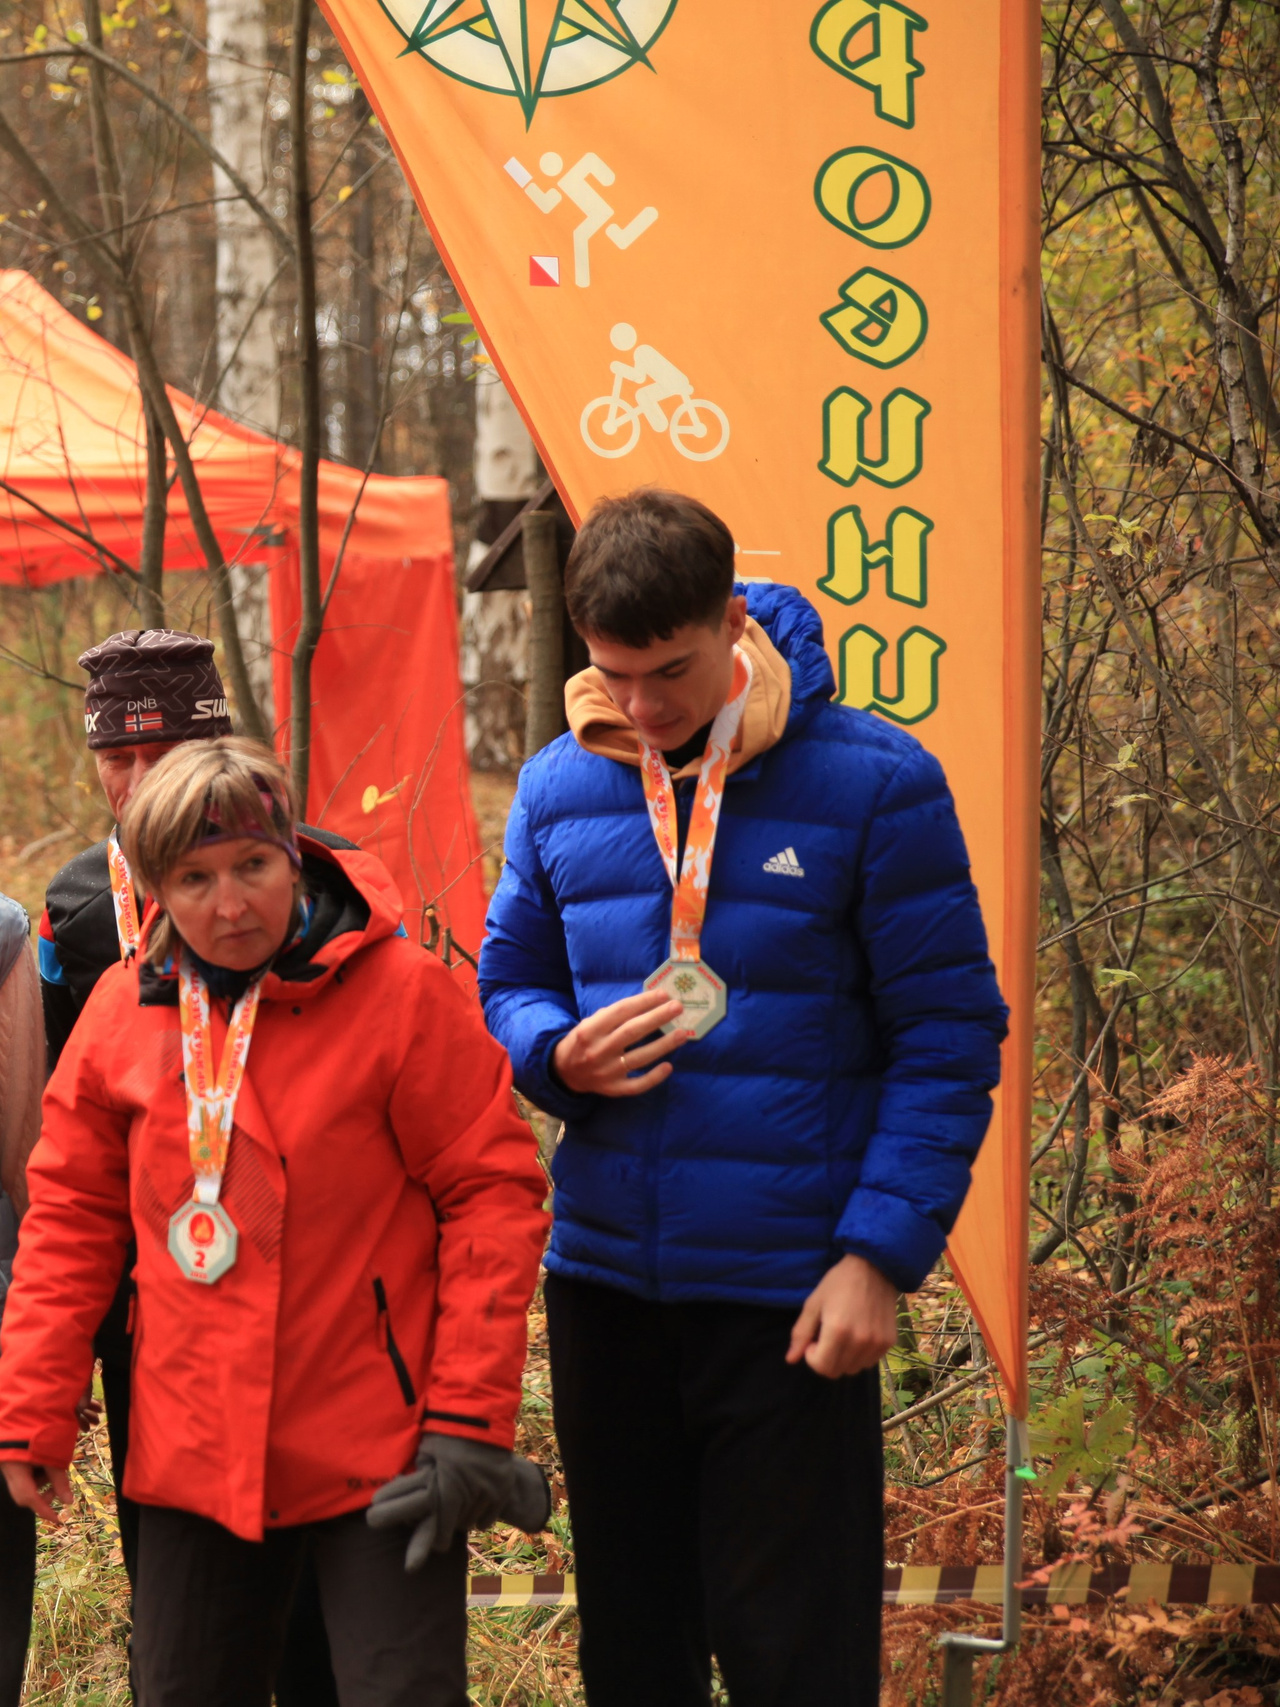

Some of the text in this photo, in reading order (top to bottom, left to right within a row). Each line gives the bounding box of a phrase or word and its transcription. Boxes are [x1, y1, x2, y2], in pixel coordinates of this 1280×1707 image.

[127, 696, 158, 713] DNB
[191, 698, 230, 720] SW
[649, 745, 666, 787] ДЕСЯТ
[762, 862, 805, 878] adidas
[121, 886, 135, 944] ГОРЯЧАЯ
[193, 1031, 207, 1098] ГОРЯЧАЯ
[194, 1250, 206, 1269] 2
